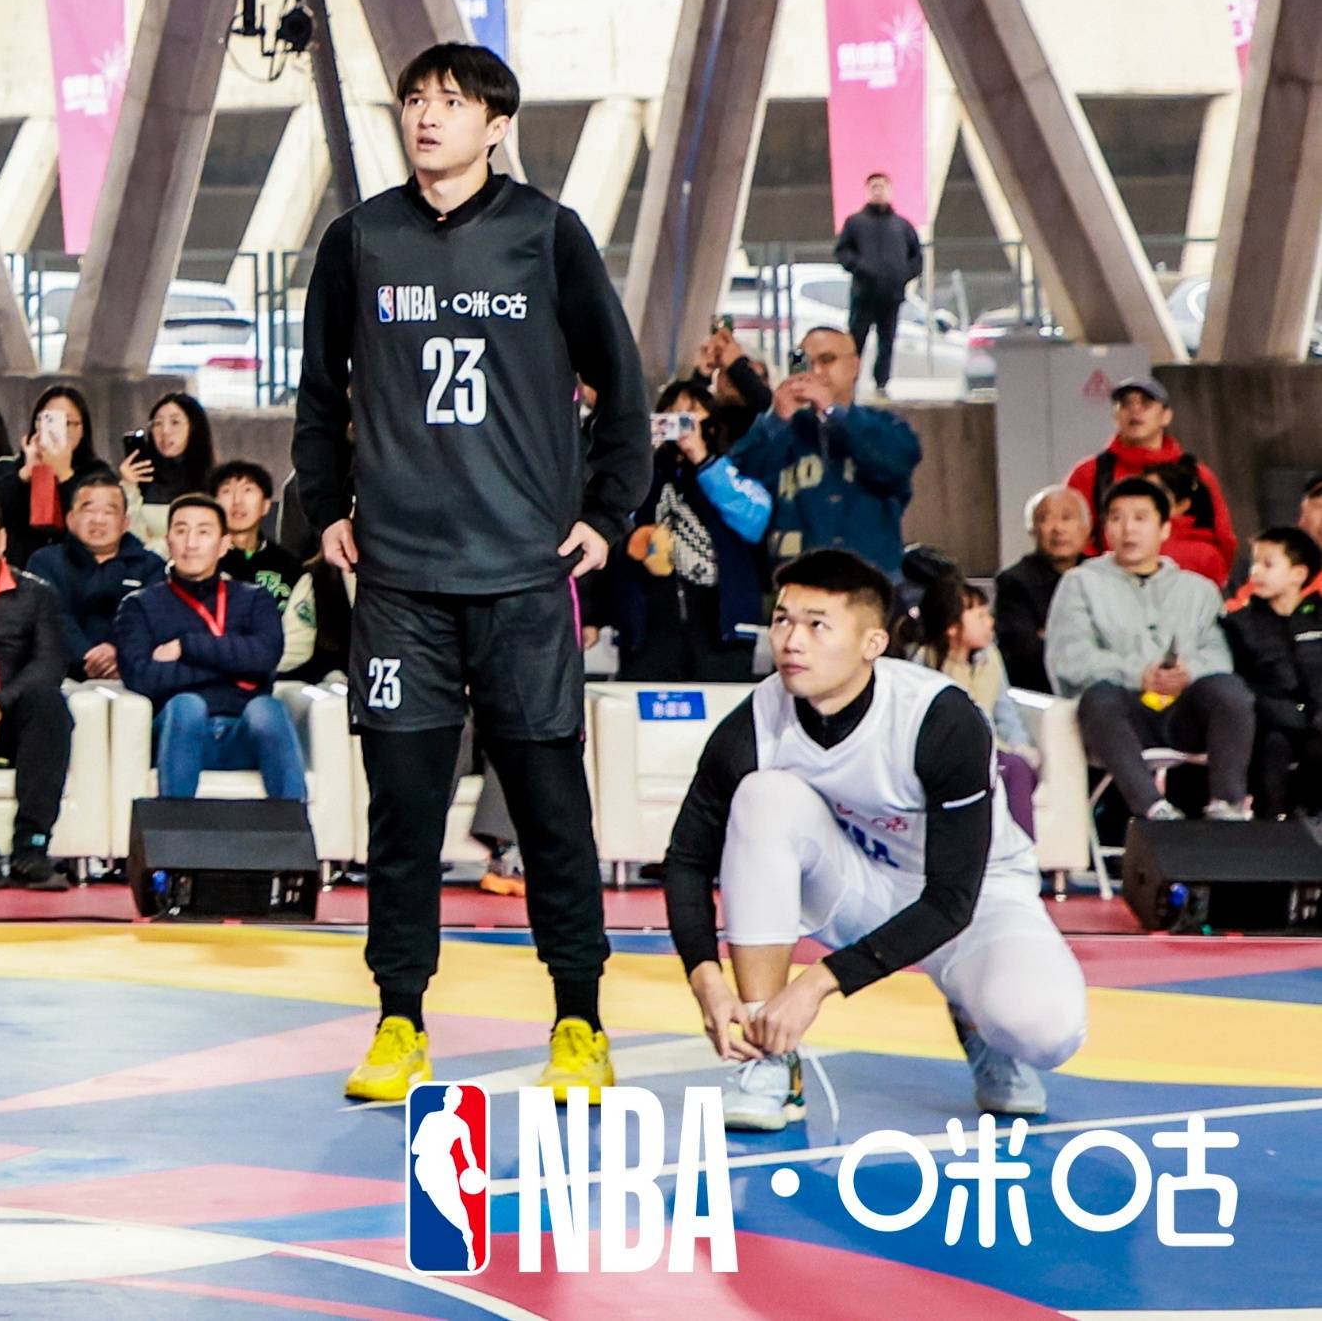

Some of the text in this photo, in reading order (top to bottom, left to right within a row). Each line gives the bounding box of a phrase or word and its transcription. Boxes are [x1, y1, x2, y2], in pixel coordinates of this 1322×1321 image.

[395, 284, 529, 323] NBA 咪咕
[421, 335, 488, 426] 23
[367, 656, 403, 711] 23
